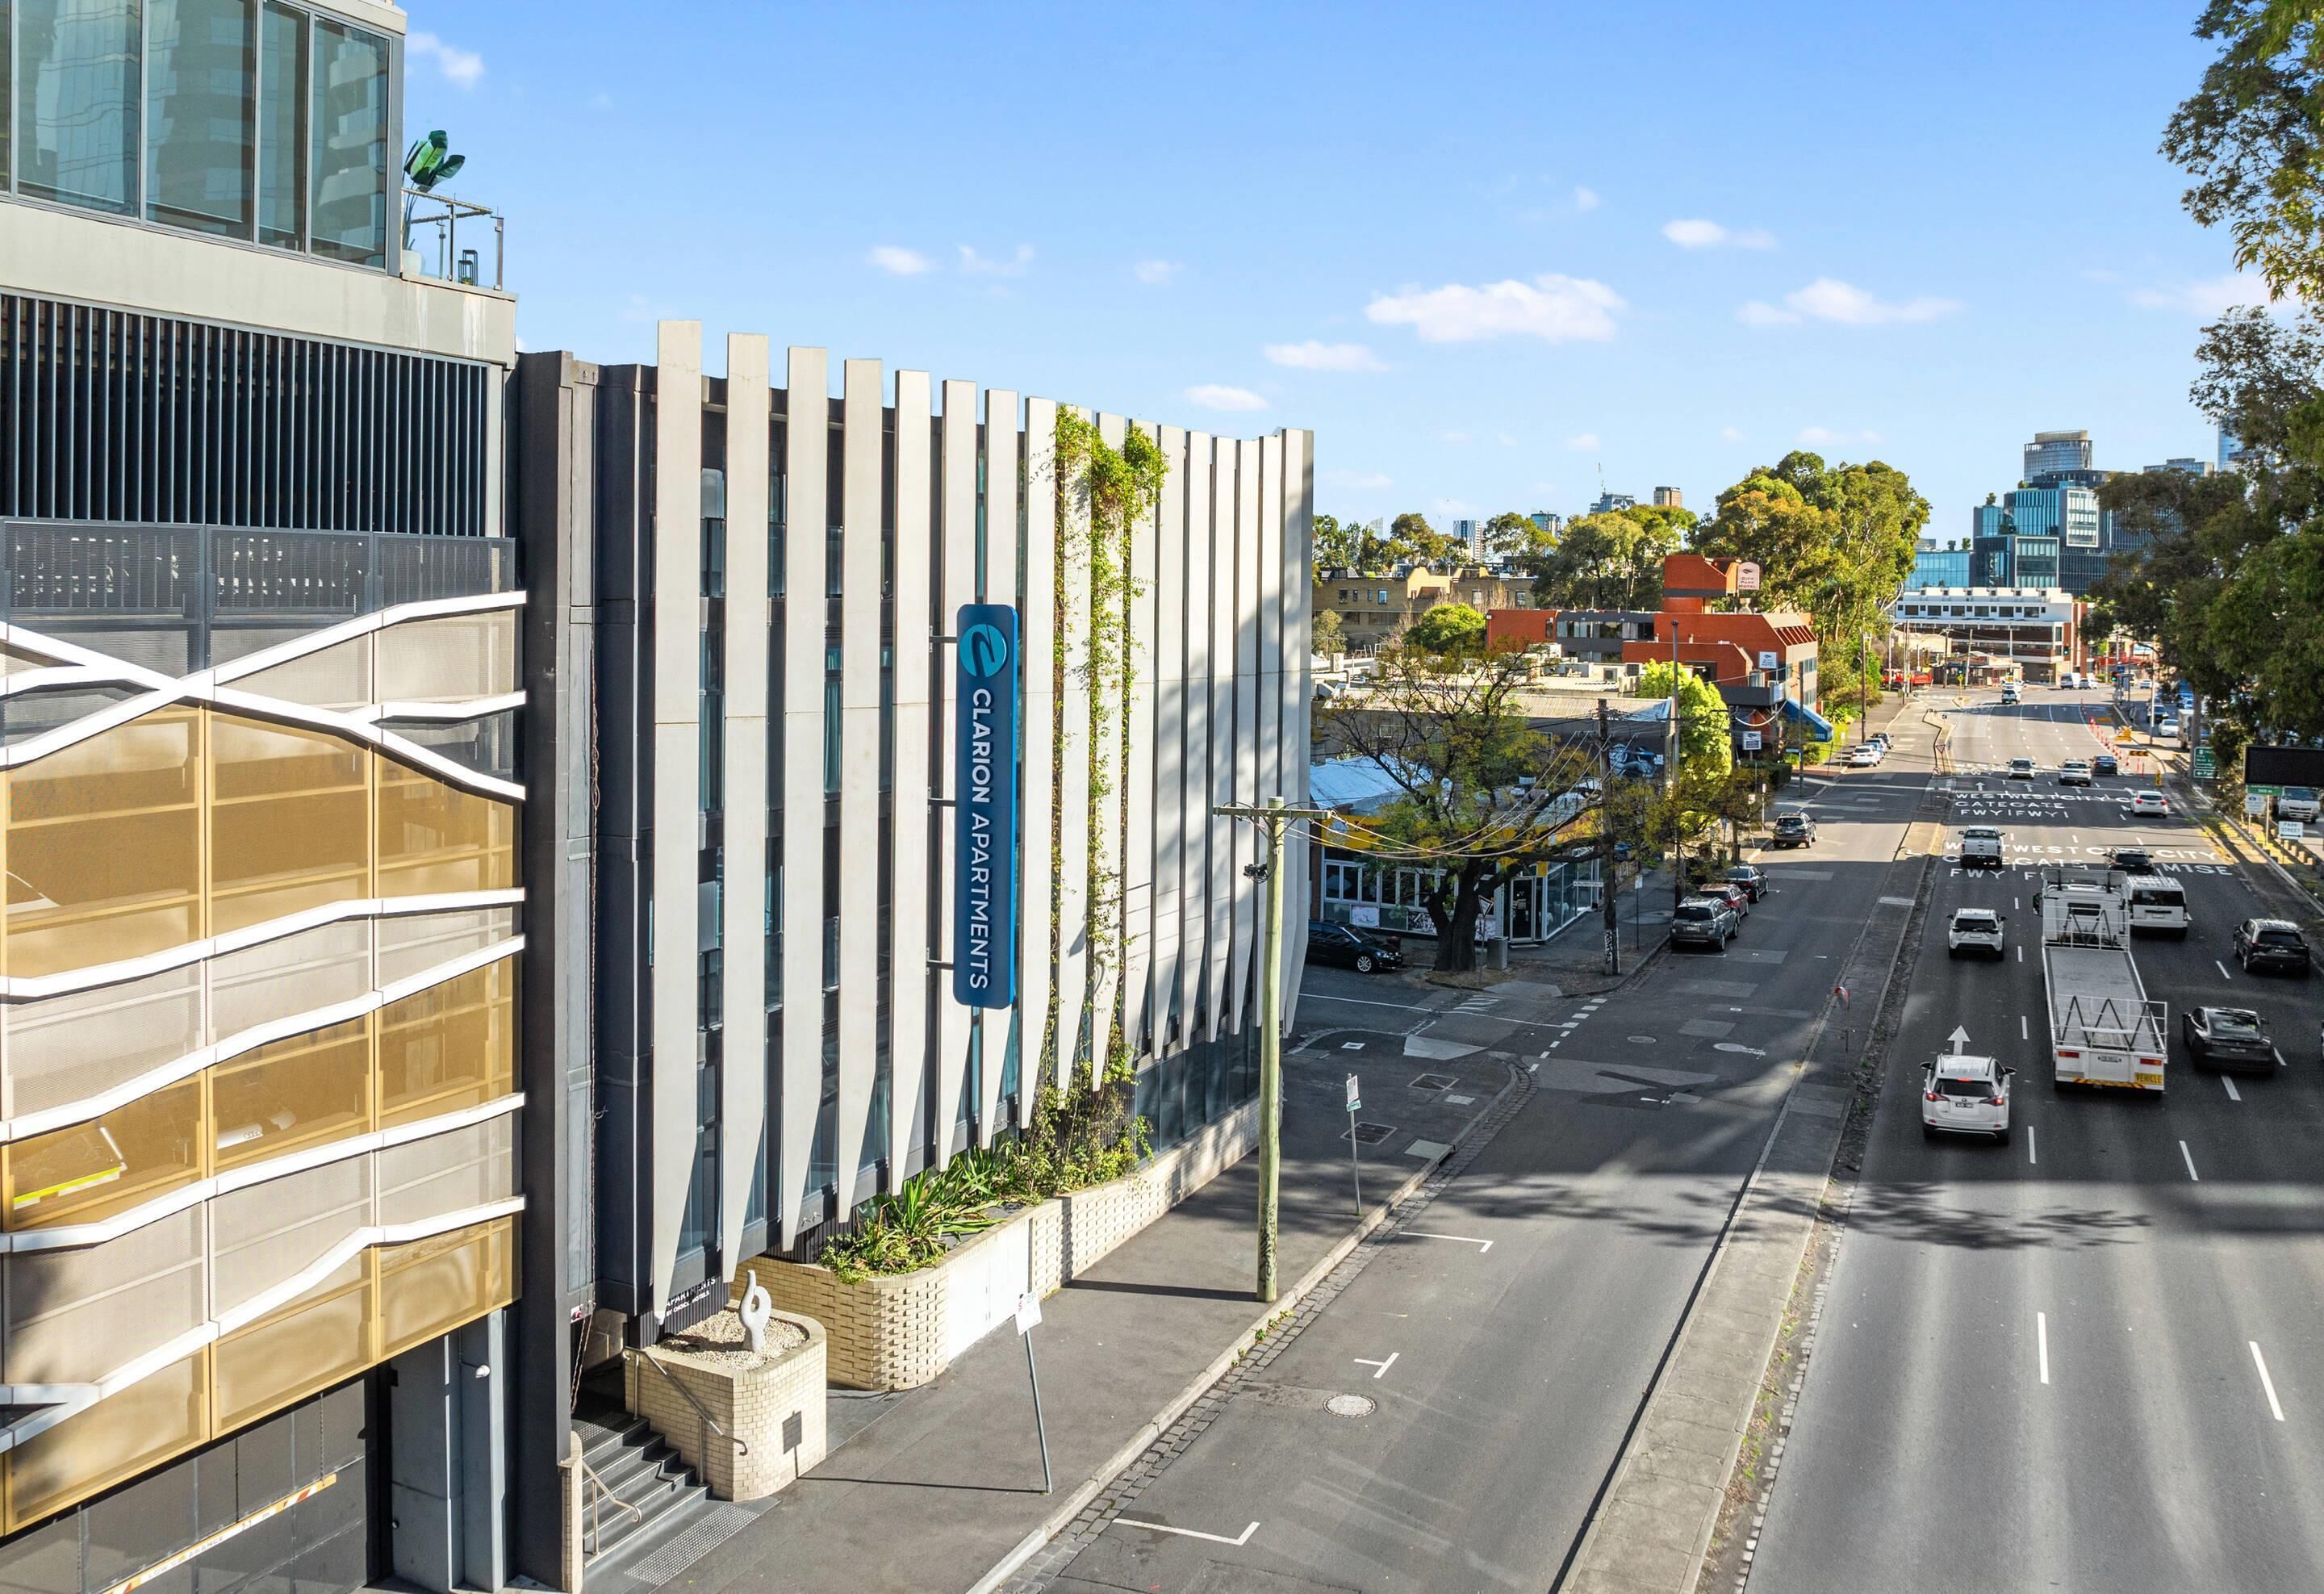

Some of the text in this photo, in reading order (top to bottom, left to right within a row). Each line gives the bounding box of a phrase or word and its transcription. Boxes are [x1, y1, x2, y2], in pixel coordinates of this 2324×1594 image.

[2016, 810, 2058, 818] FWY
[970, 688, 992, 989] CLARION APARTMENTS
[1946, 842, 2011, 852] WT
[2012, 845, 2079, 855] WEST
[2155, 849, 2217, 860] CITY
[2016, 858, 2084, 868] GATE
[1950, 868, 2005, 880] FWY
[2135, 1073, 2163, 1084] VEHICLE
[148, 1566, 169, 1579] LOW
[171, 1536, 224, 1566] CARANCE
